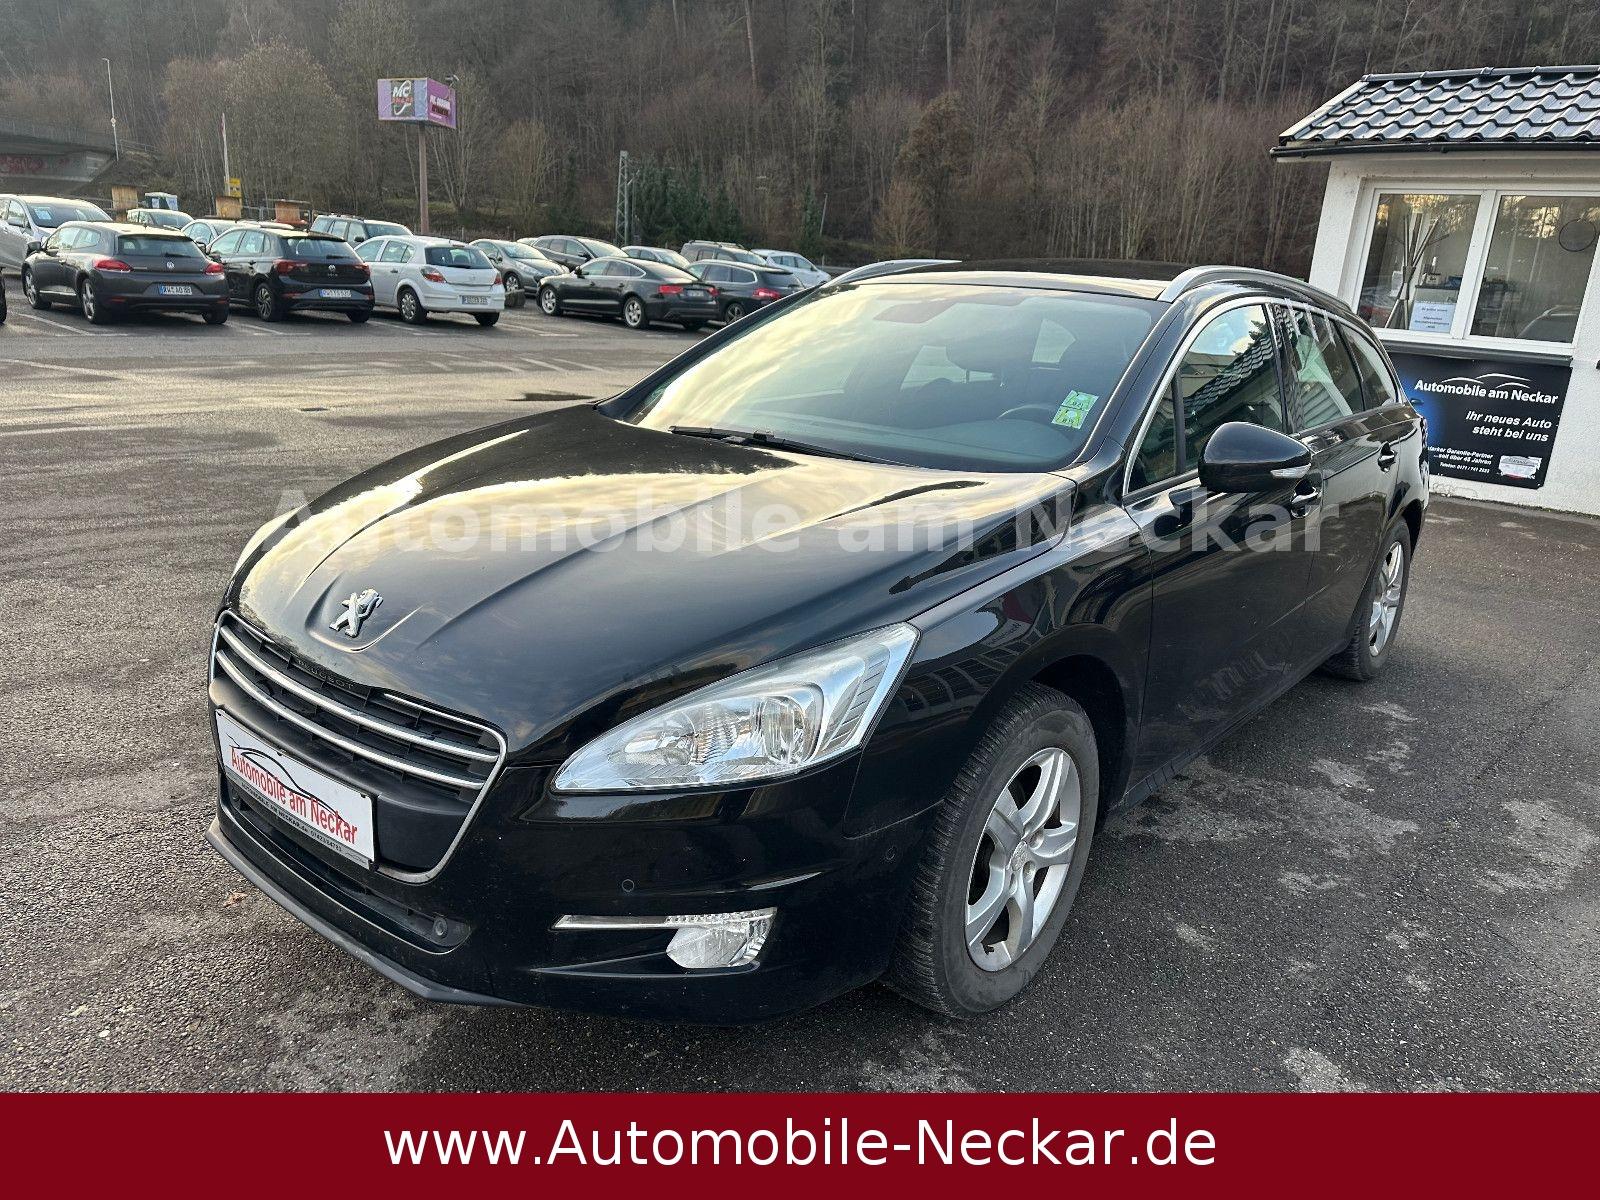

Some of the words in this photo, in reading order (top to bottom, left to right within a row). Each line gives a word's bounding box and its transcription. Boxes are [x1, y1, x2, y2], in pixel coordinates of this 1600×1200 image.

[1414, 379, 1486, 397] Automobile
[1487, 388, 1508, 400] am
[1511, 389, 1559, 404] Neckar
[1465, 410, 1482, 421] Ihr
[1484, 414, 1521, 426] neues
[1522, 416, 1552, 429] Auto
[1472, 425, 1502, 437] steht
[1504, 427, 1523, 439] bei
[1525, 431, 1549, 442] uns
[231, 746, 287, 805] Automobile
[289, 791, 307, 818] am
[310, 797, 359, 844] Neckar
